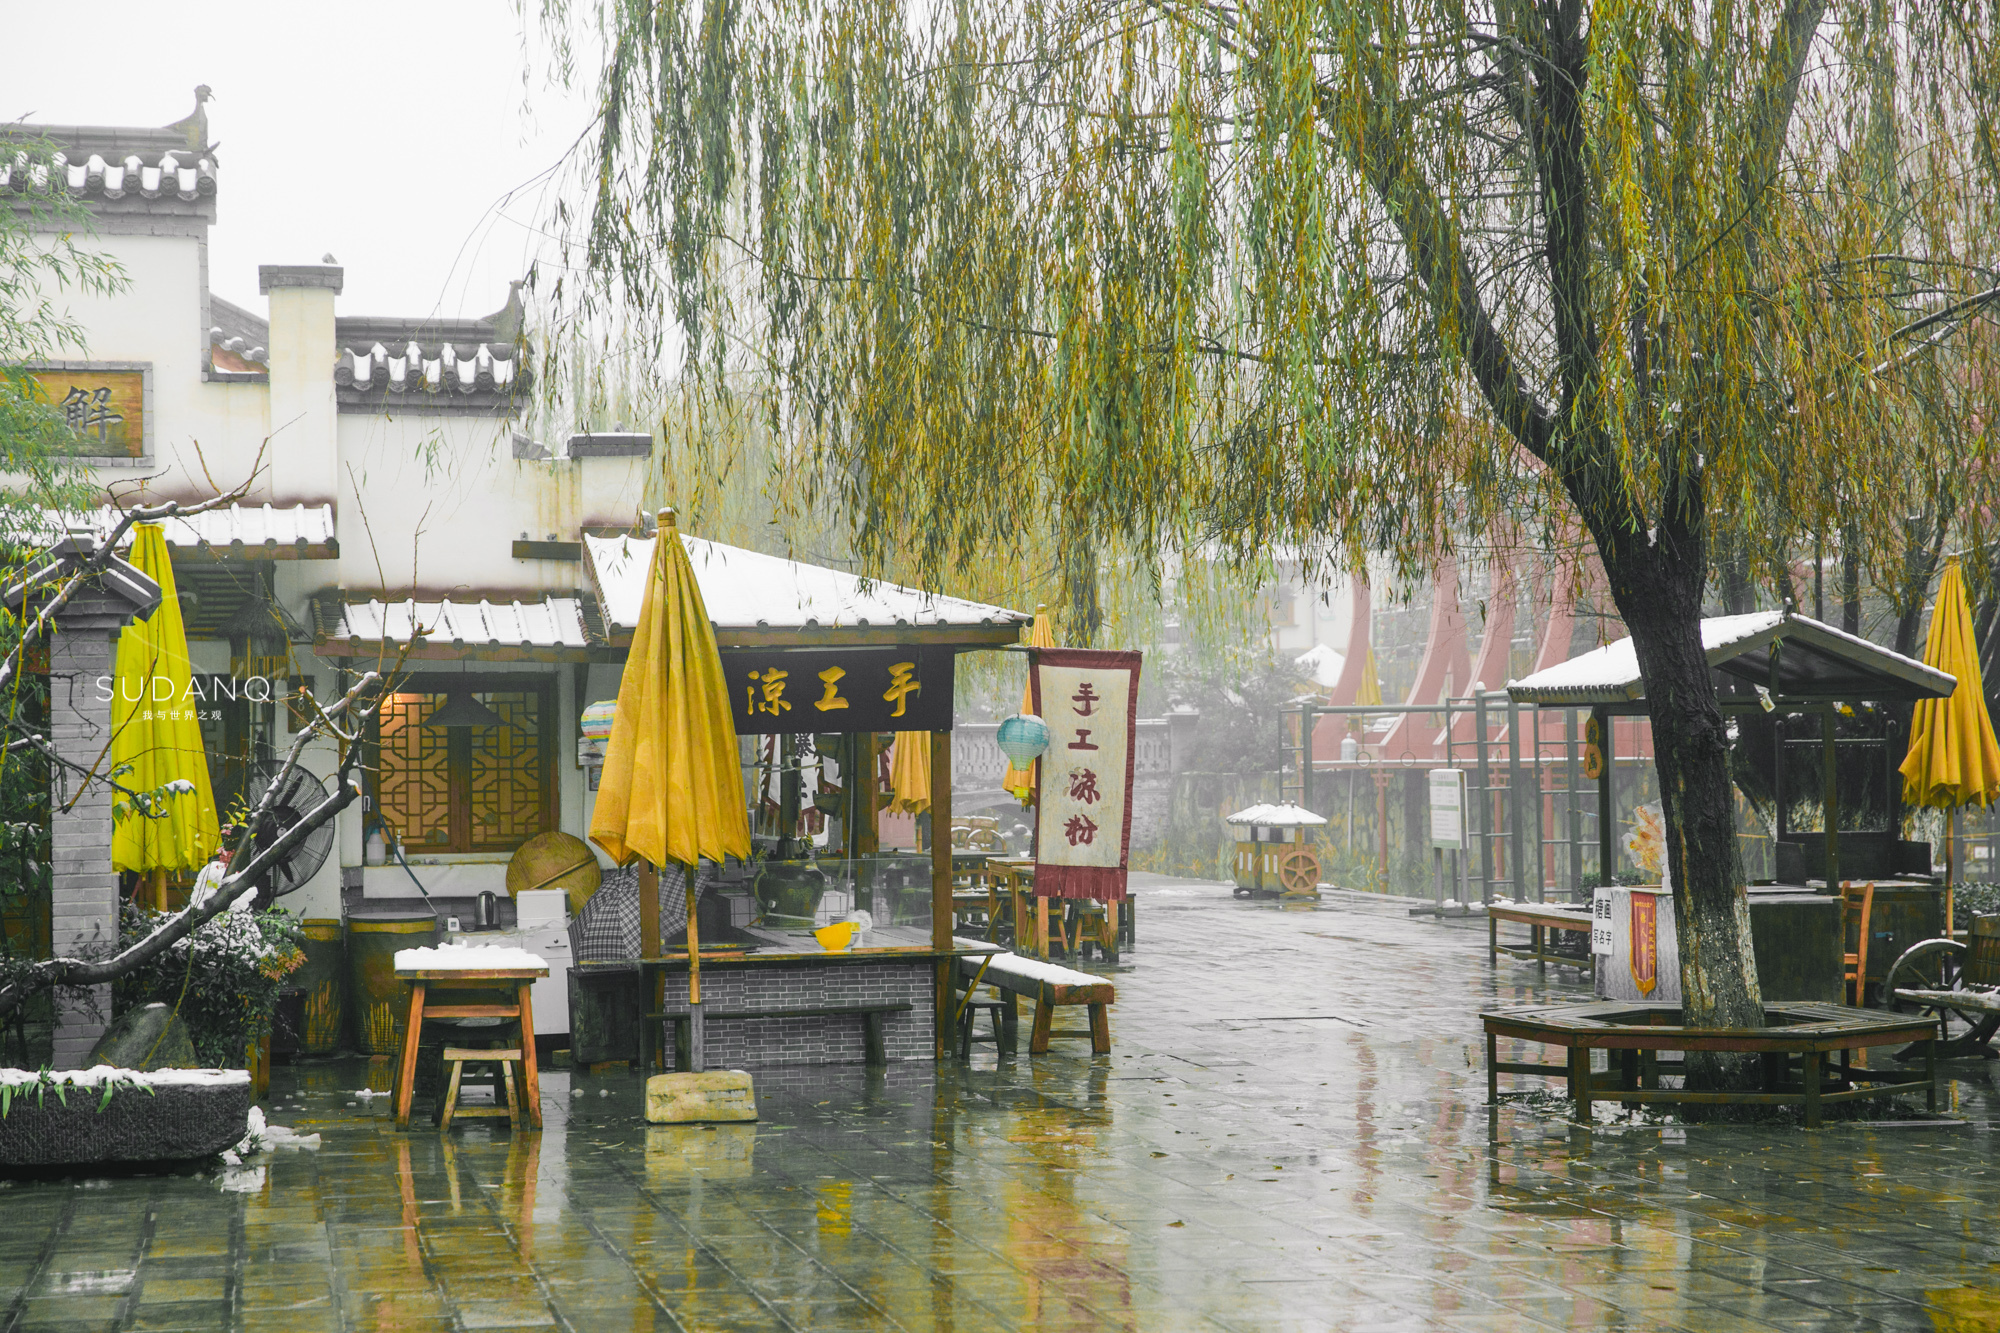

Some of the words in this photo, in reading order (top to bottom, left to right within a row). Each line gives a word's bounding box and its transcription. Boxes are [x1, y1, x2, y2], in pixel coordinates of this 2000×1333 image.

[61, 385, 125, 445] 解
[1593, 928, 1612, 946] 写名字
